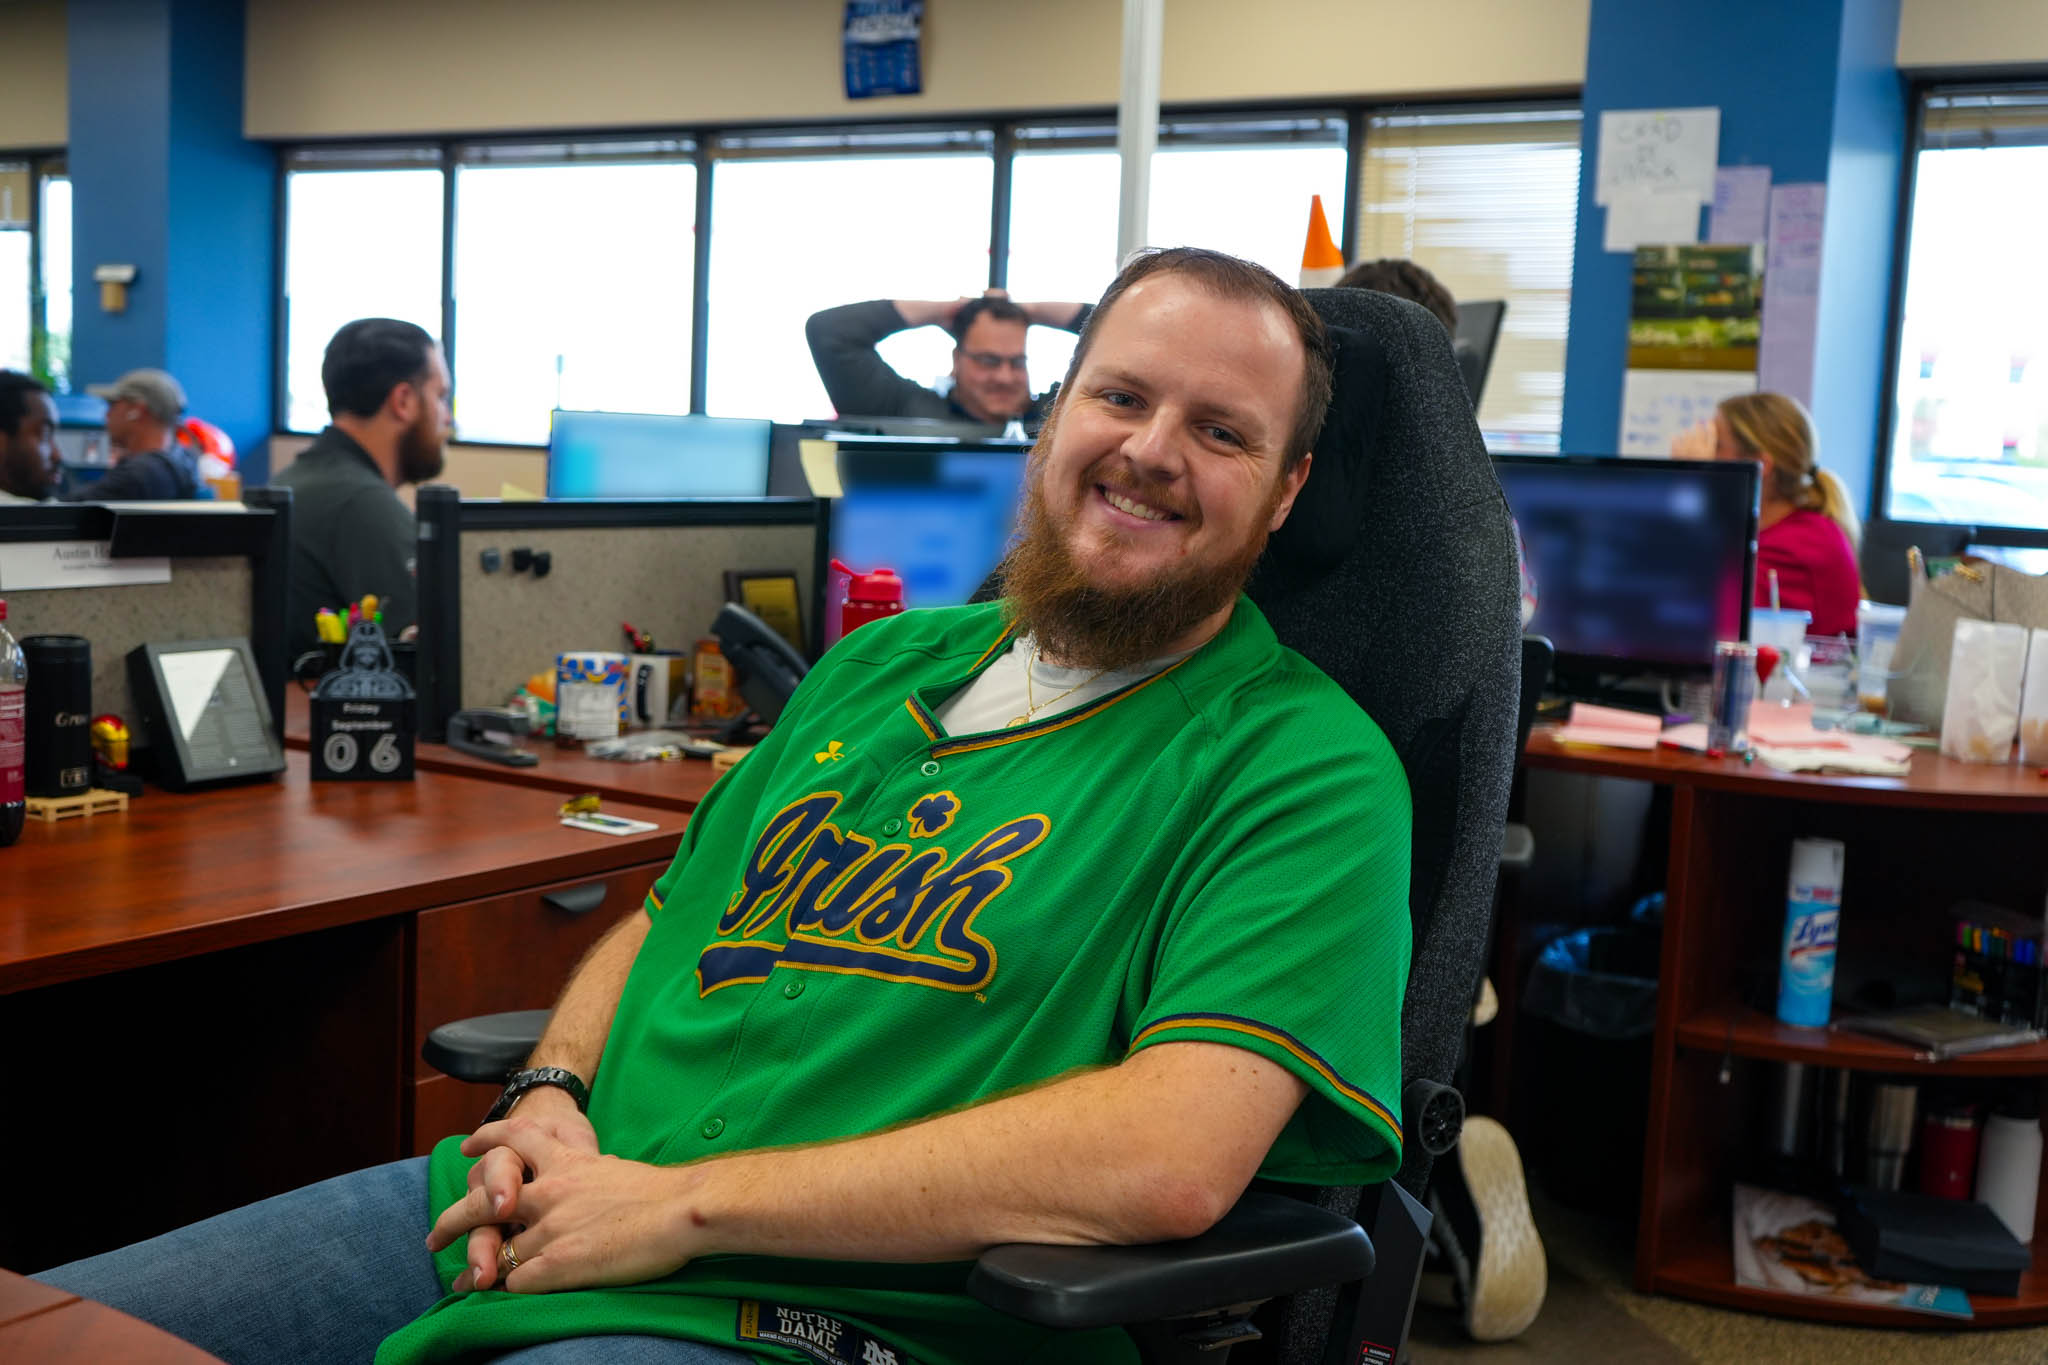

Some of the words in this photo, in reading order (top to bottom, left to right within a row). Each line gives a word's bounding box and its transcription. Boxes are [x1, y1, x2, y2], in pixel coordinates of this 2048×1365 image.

[342, 702, 381, 715] Friday
[330, 719, 394, 732] September
[704, 790, 1052, 990] Irish
[775, 1306, 843, 1337] NOTRE
[779, 1318, 838, 1353] DAME
